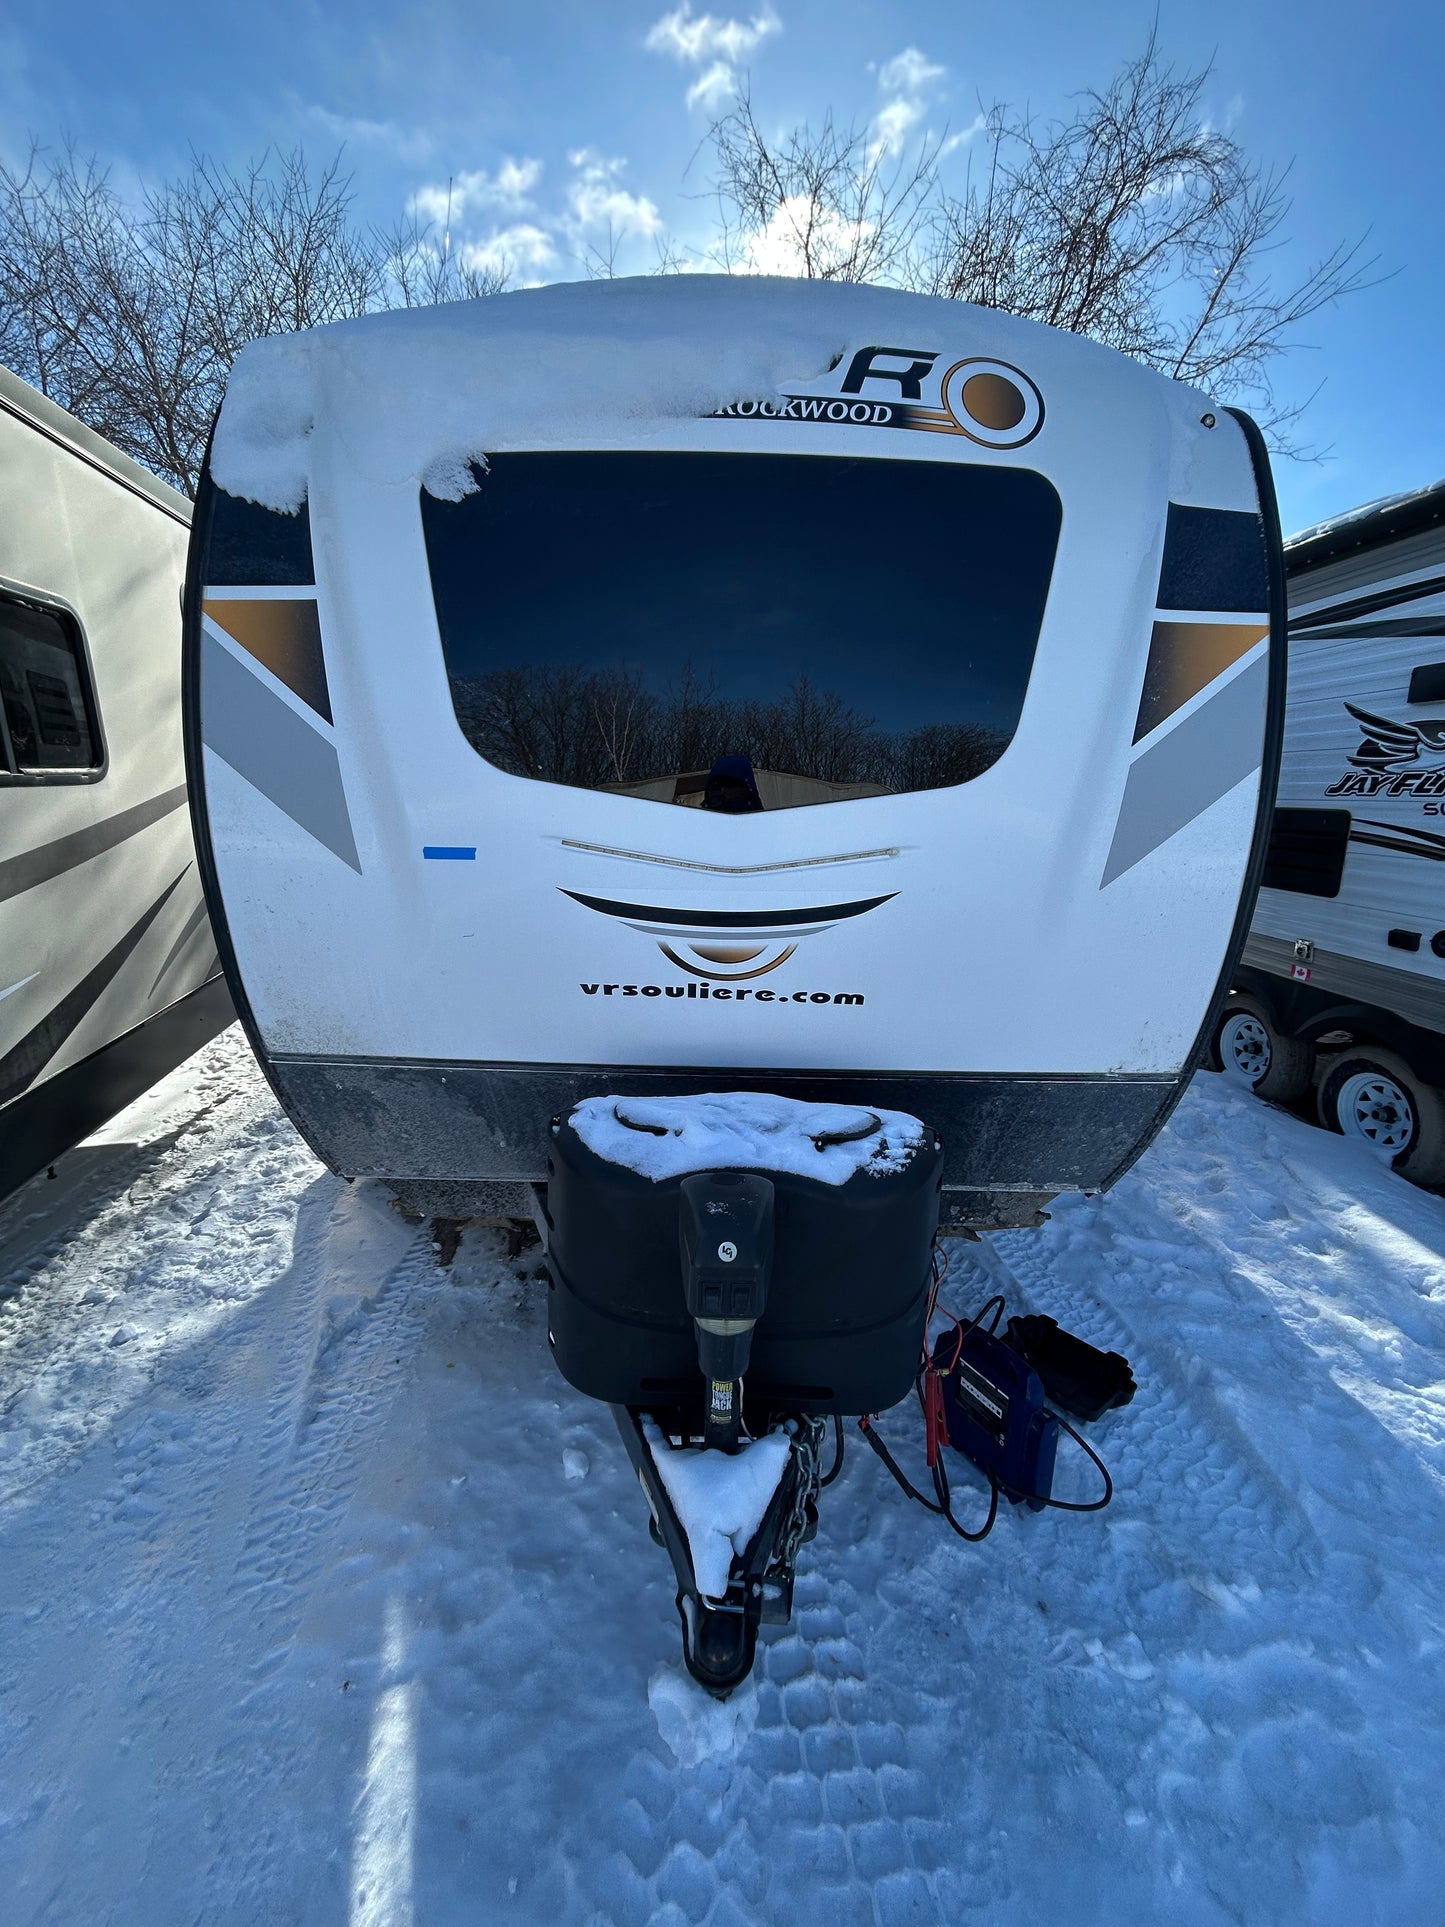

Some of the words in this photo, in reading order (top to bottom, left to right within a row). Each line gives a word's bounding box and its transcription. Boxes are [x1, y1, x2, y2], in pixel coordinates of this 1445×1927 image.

[1325, 772, 1396, 796] JAY
[580, 982, 865, 1005] vrsouliere.com
[712, 1381, 733, 1391] POWER
[712, 1400, 732, 1411] JACK
